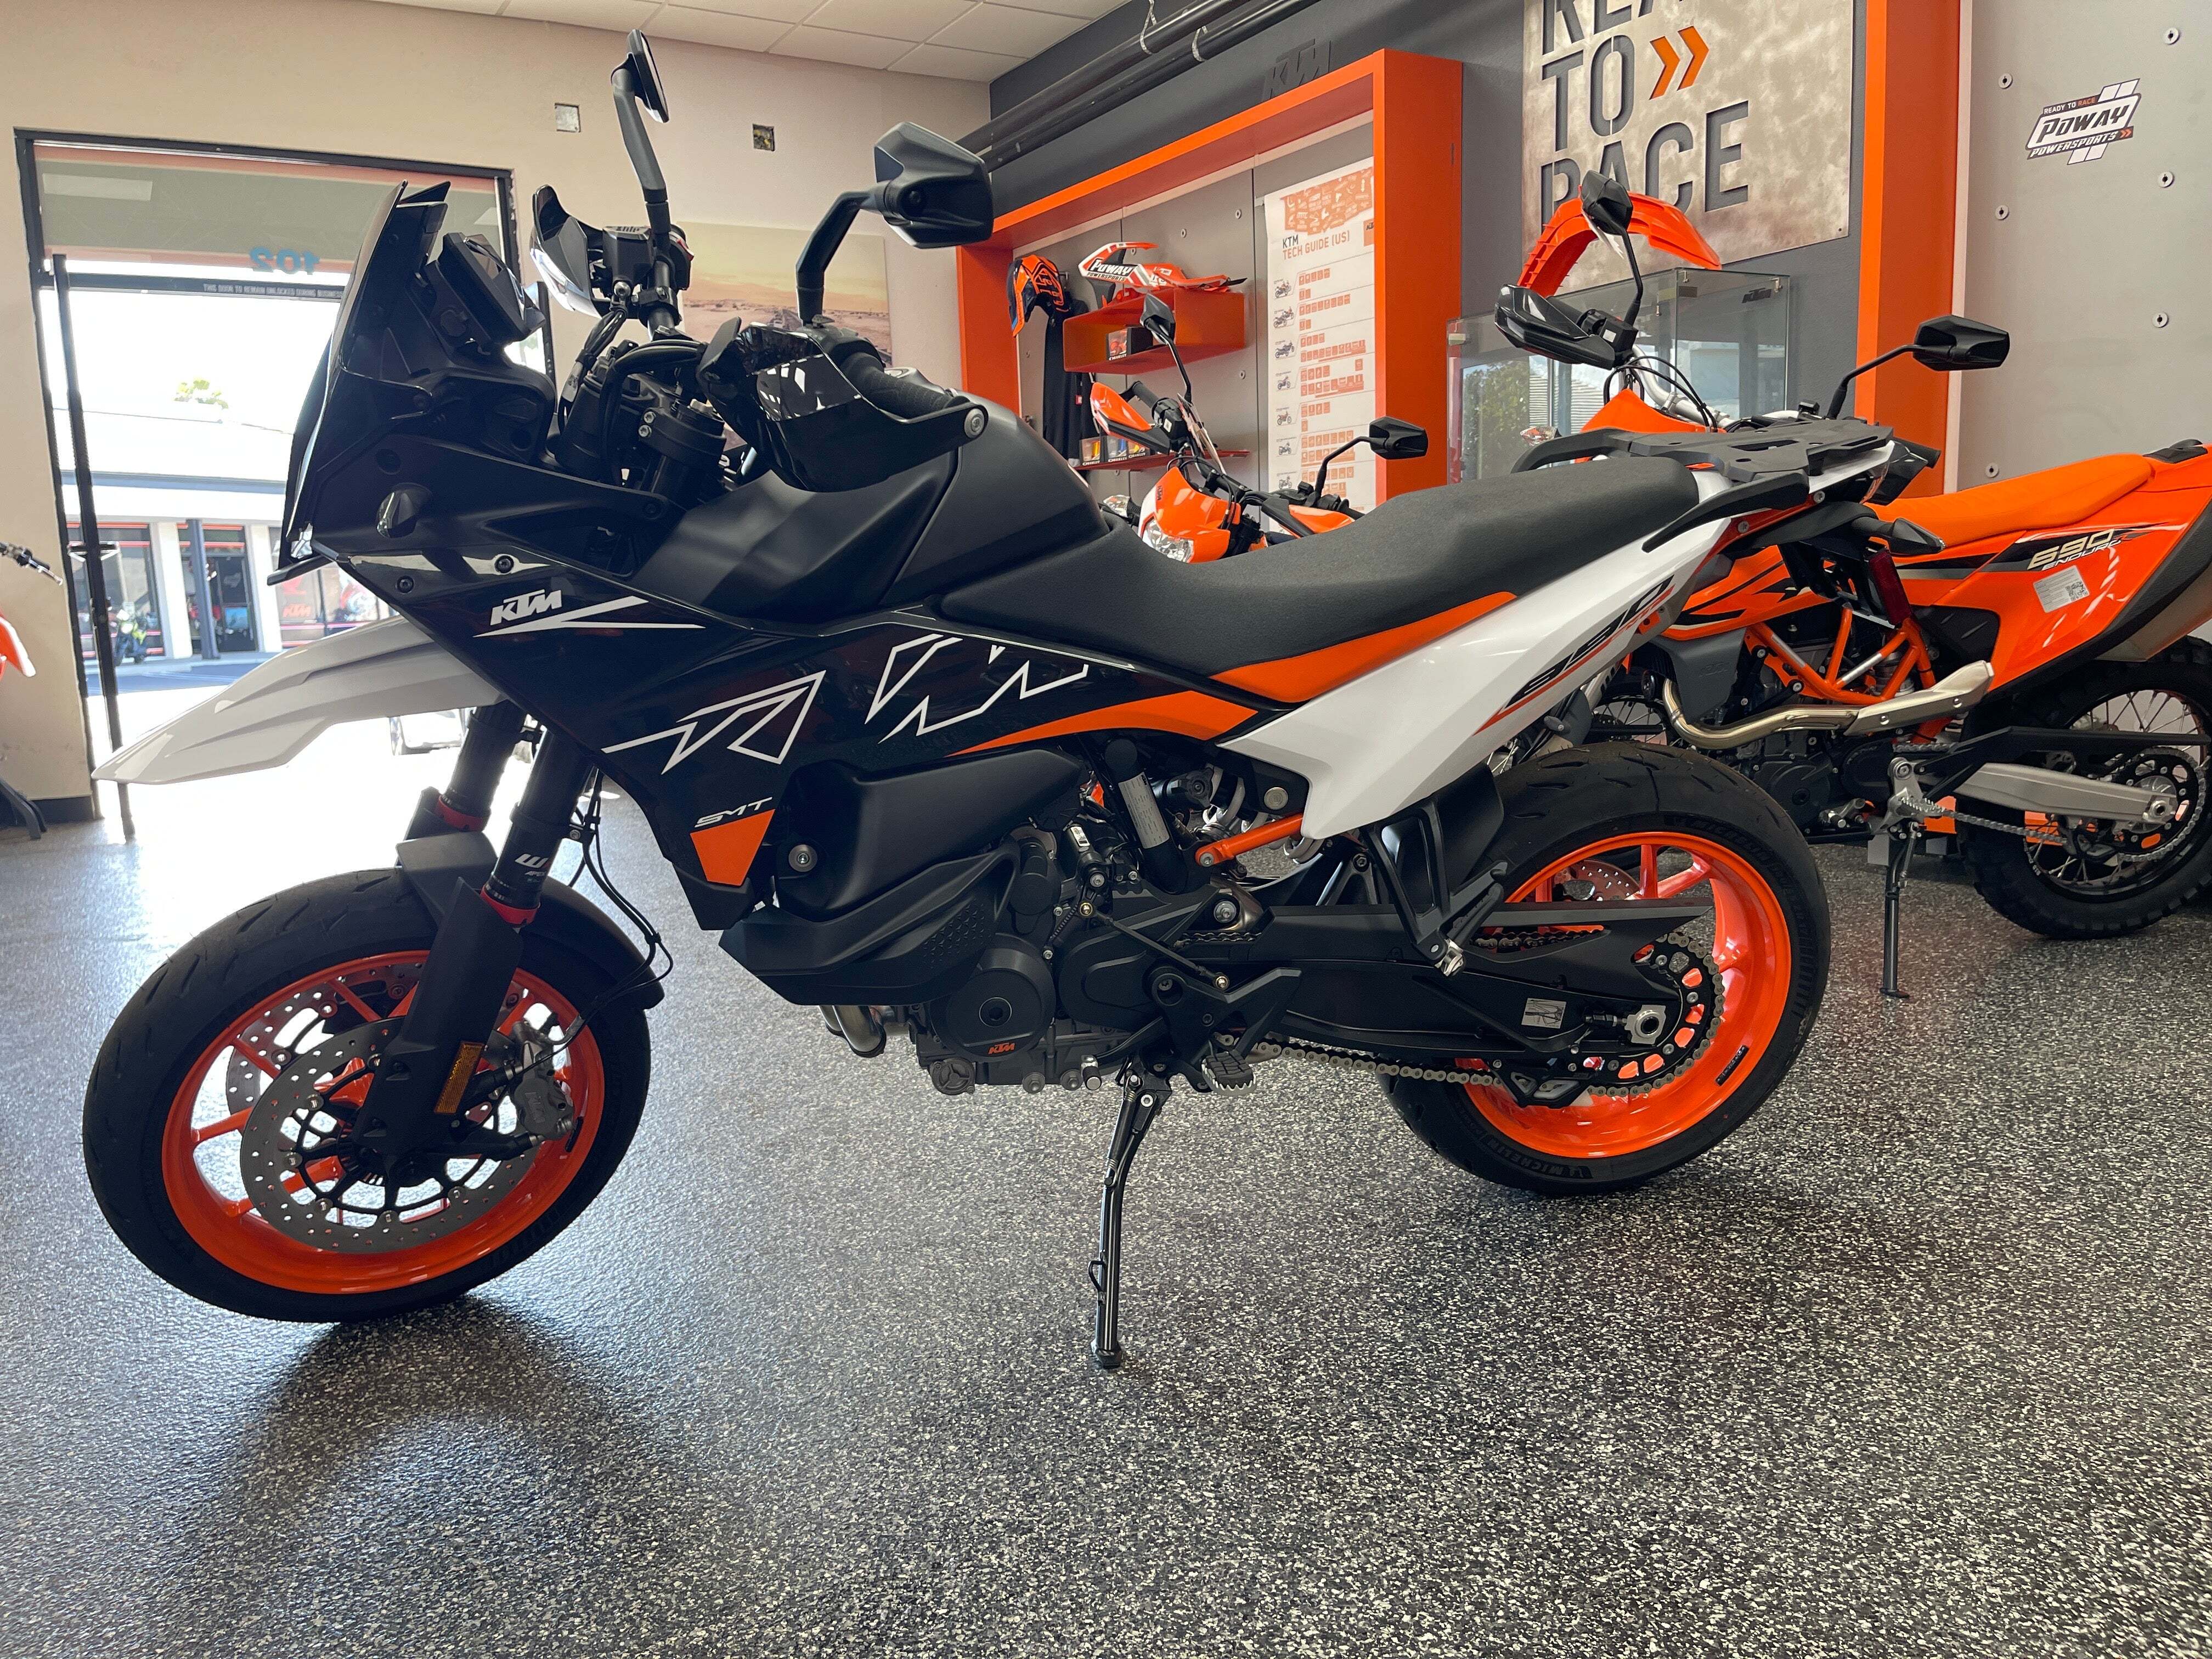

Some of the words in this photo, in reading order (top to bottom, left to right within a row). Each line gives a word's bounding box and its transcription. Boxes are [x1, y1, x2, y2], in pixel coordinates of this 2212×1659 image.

[1542, 35, 1635, 152] TO
[2044, 105, 2064, 114] READY
[2078, 97, 2096, 106] RACE
[2036, 105, 2130, 143] POWAY
[2030, 131, 2119, 157] POWERSPORTS
[1283, 234, 1299, 249] KTM
[1283, 245, 1303, 260] TECH
[1305, 236, 1329, 253] GUIDE
[1090, 259, 1133, 276] POWAY
[1742, 287, 1772, 304] KTM
[2027, 529, 2114, 571] 690
[2041, 539, 2121, 571] ENDURO
[490, 589, 562, 625] KTM
[1504, 574, 1675, 709] 890
[694, 797, 773, 828] SMT
[988, 1042, 1015, 1055] KTM
[1487, 1137, 1564, 1176] MICHELIN
